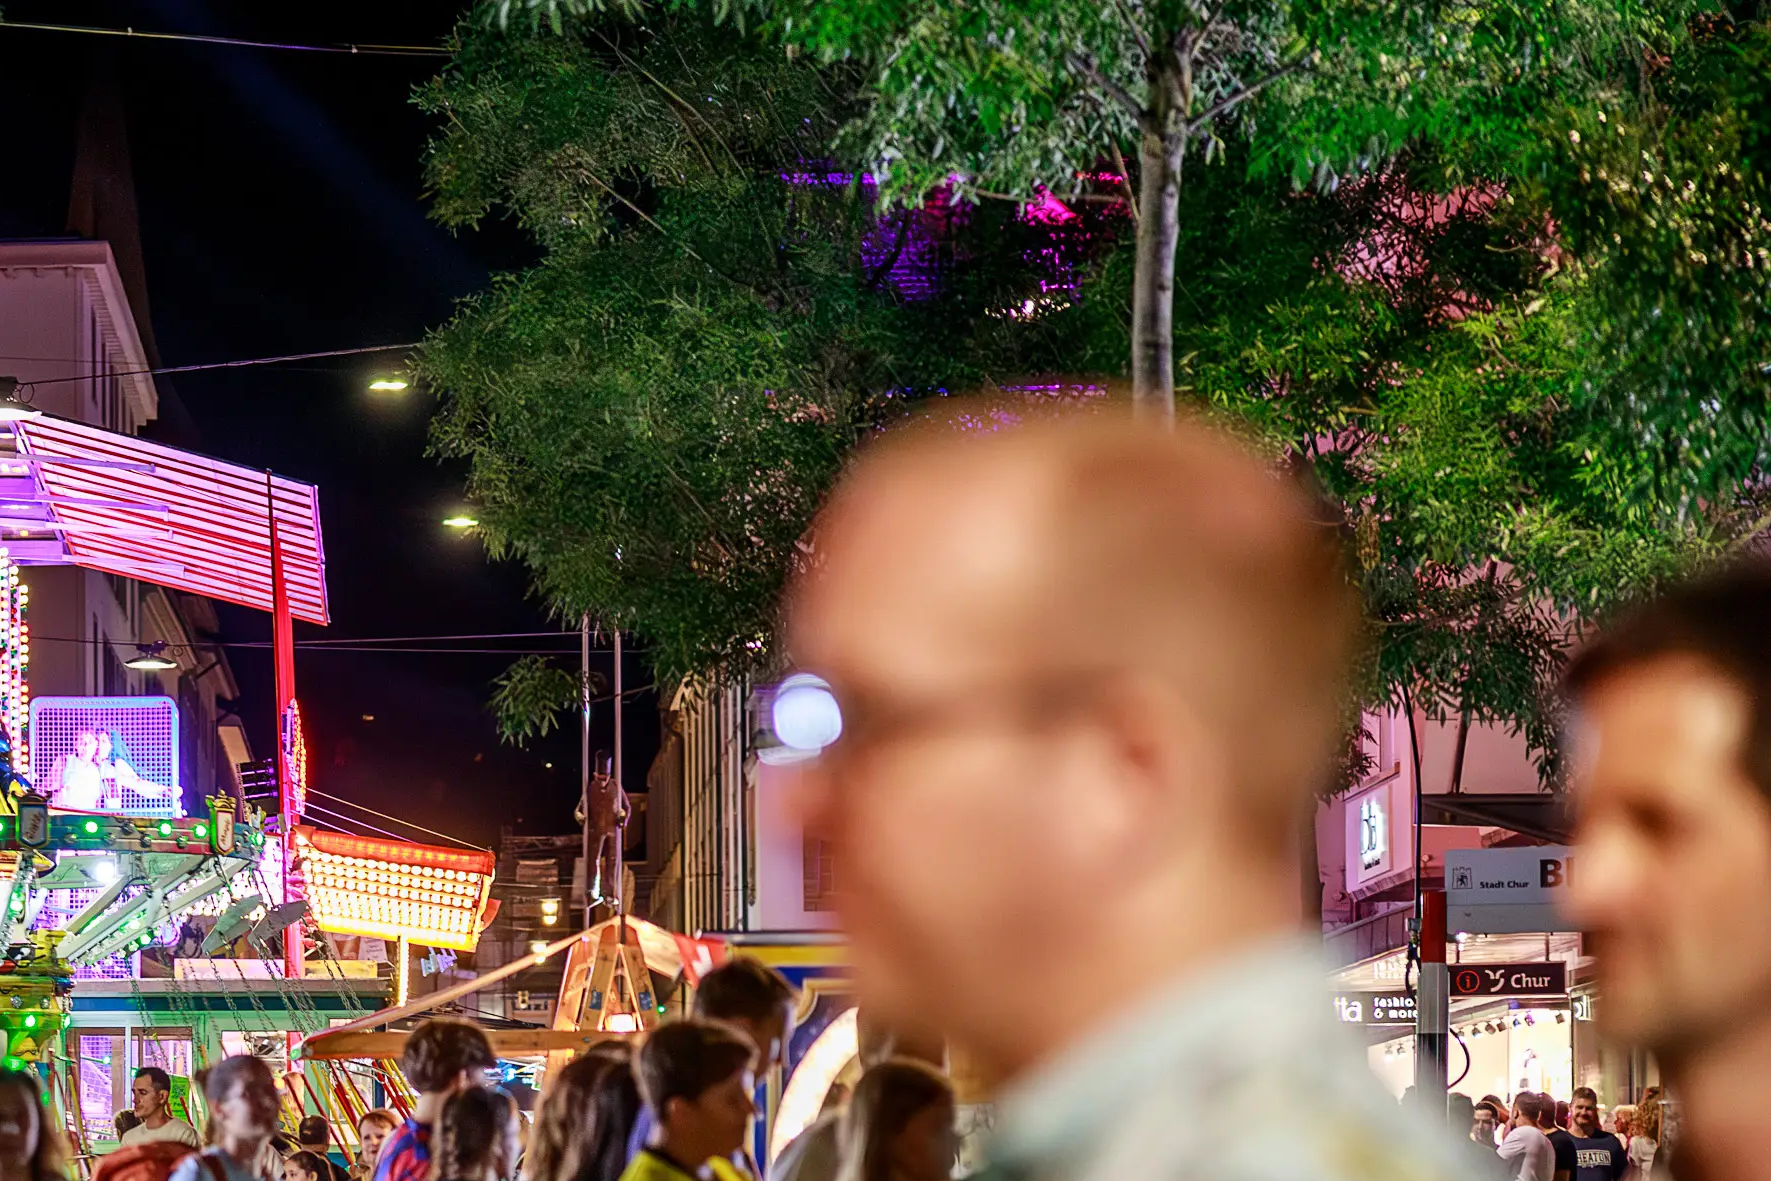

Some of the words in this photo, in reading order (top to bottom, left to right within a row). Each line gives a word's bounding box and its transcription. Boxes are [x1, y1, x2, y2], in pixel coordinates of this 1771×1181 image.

[1479, 880, 1505, 889] Stadt
[1507, 880, 1530, 889] Chur
[1510, 972, 1552, 989] Chur
[1373, 996, 1417, 1008] fashio
[1577, 1151, 1610, 1164] HEATON
